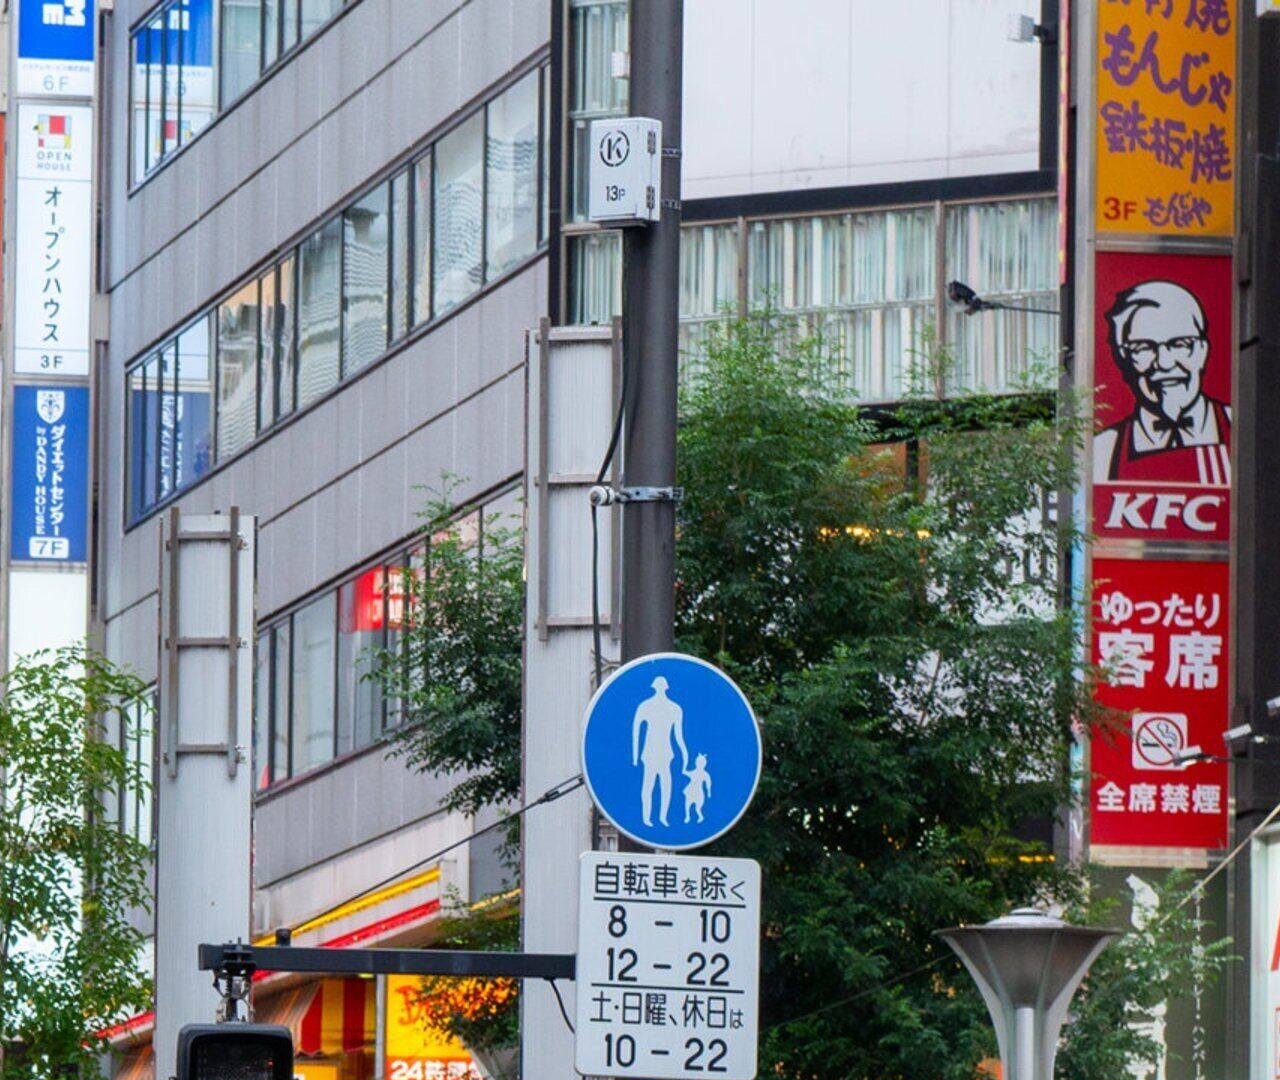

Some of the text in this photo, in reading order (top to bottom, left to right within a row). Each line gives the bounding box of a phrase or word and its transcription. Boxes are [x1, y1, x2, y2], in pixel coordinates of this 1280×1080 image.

[43, 75, 69, 91] 6F
[1102, 24, 1232, 113] もんじゃ
[36, 151, 72, 162] OPEN
[1100, 100, 1232, 184] 鉄板焼
[36, 163, 71, 172] HOUSE
[1103, 196, 1137, 221] 3F
[43, 186, 66, 342] オープンハウス
[40, 355, 63, 369] 3F
[50, 424, 66, 536] ダイエットセンター
[34, 486, 47, 535] HOUSE
[1105, 493, 1225, 531] KFC
[35, 540, 64, 555] 7F
[1101, 593, 1221, 628] ゆったり
[1097, 632, 1223, 691] 客席
[1096, 782, 1222, 814] 全席禁煙
[595, 862, 747, 903] 自転車を除く
[699, 909, 732, 943] 10
[606, 947, 639, 982] 12
[686, 952, 730, 987] 22
[604, 1032, 637, 1068] 10
[683, 1038, 728, 1073] 22
